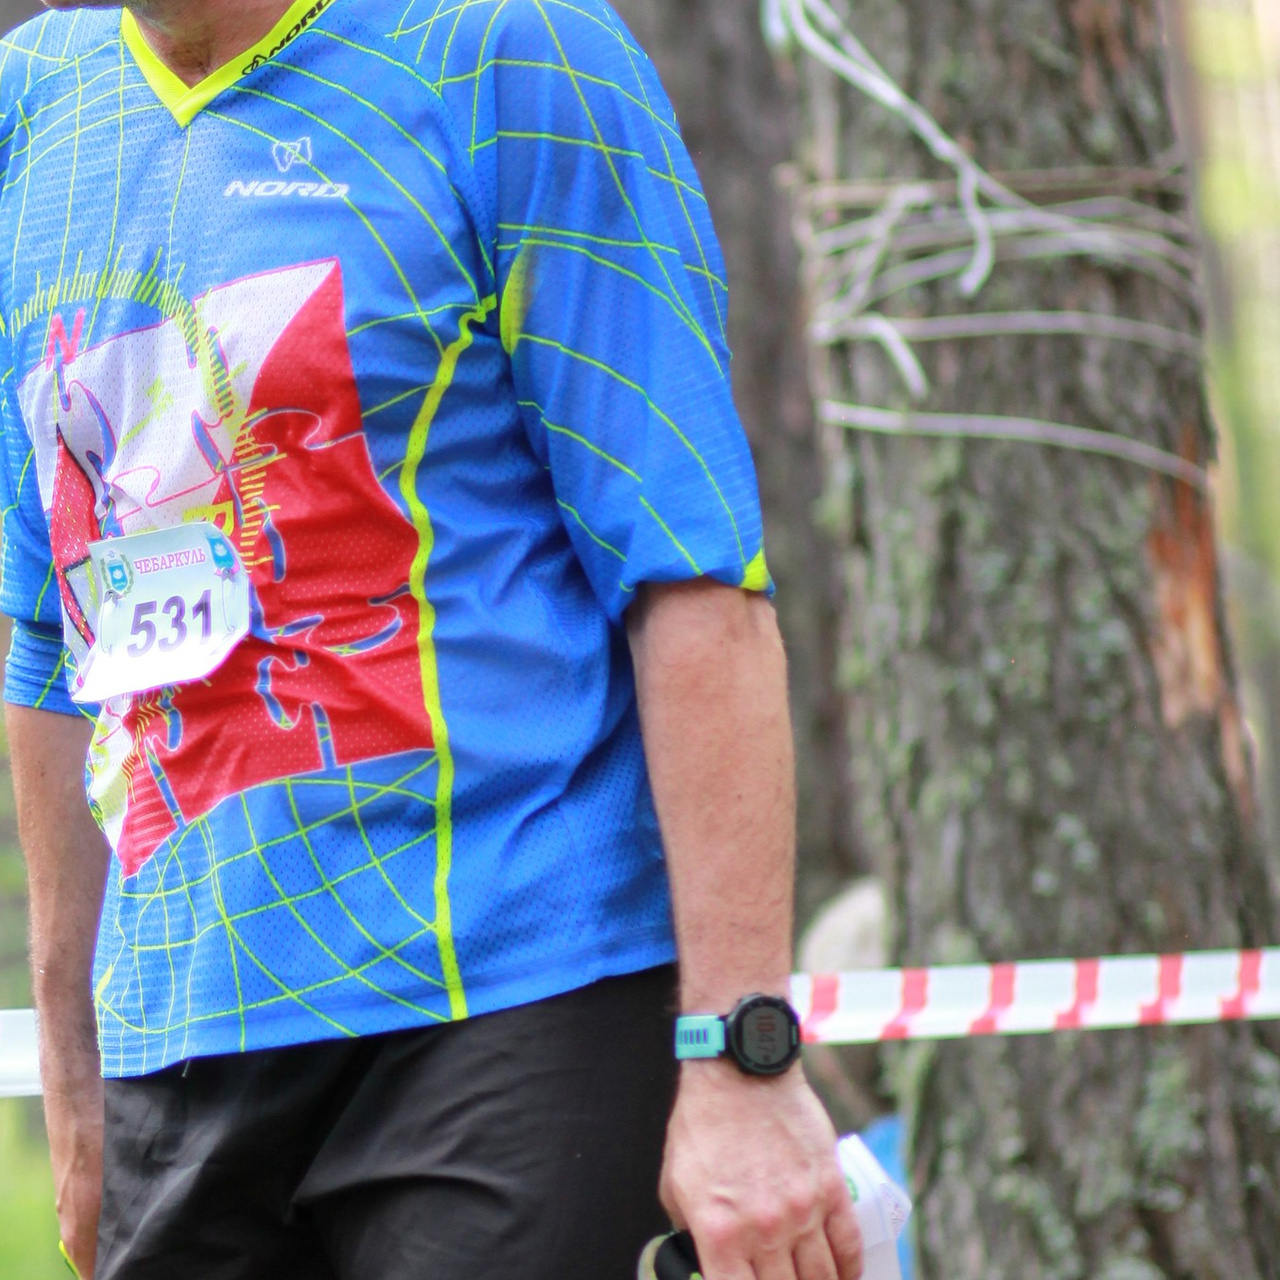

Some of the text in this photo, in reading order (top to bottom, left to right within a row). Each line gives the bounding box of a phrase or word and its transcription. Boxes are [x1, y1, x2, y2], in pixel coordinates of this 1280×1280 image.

[224, 180, 350, 198] NORD
[133, 548, 207, 575] ЧЕБАРКУЛЬ
[127, 589, 213, 658] 531
